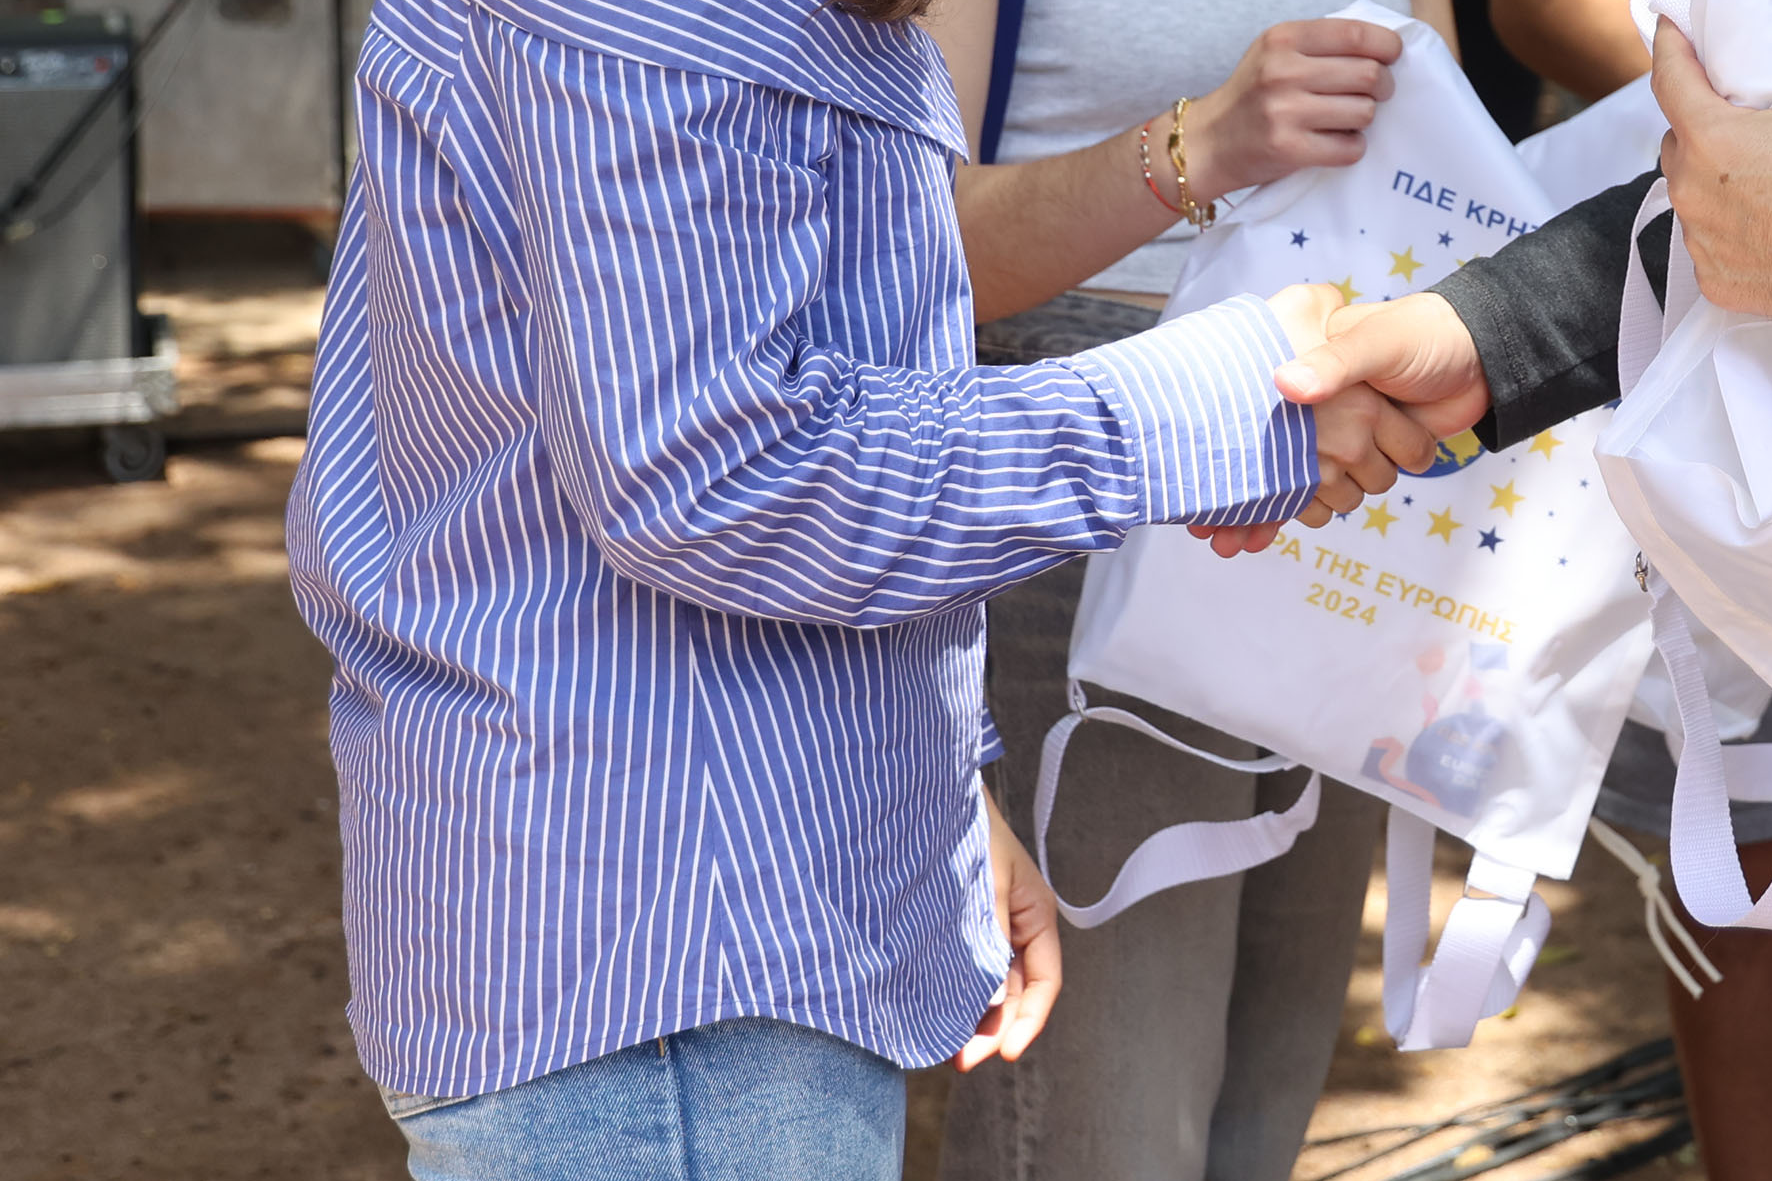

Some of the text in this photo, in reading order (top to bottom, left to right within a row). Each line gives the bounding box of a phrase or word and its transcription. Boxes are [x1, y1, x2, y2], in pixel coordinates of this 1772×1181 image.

[1392, 170, 1540, 237] ΠΔΕ ΚΡΗ
[1305, 582, 1378, 627] 2024
[1314, 546, 1371, 587] ΤΗΣ
[1374, 571, 1520, 644] ΕΥΡΩΠΗΣ
